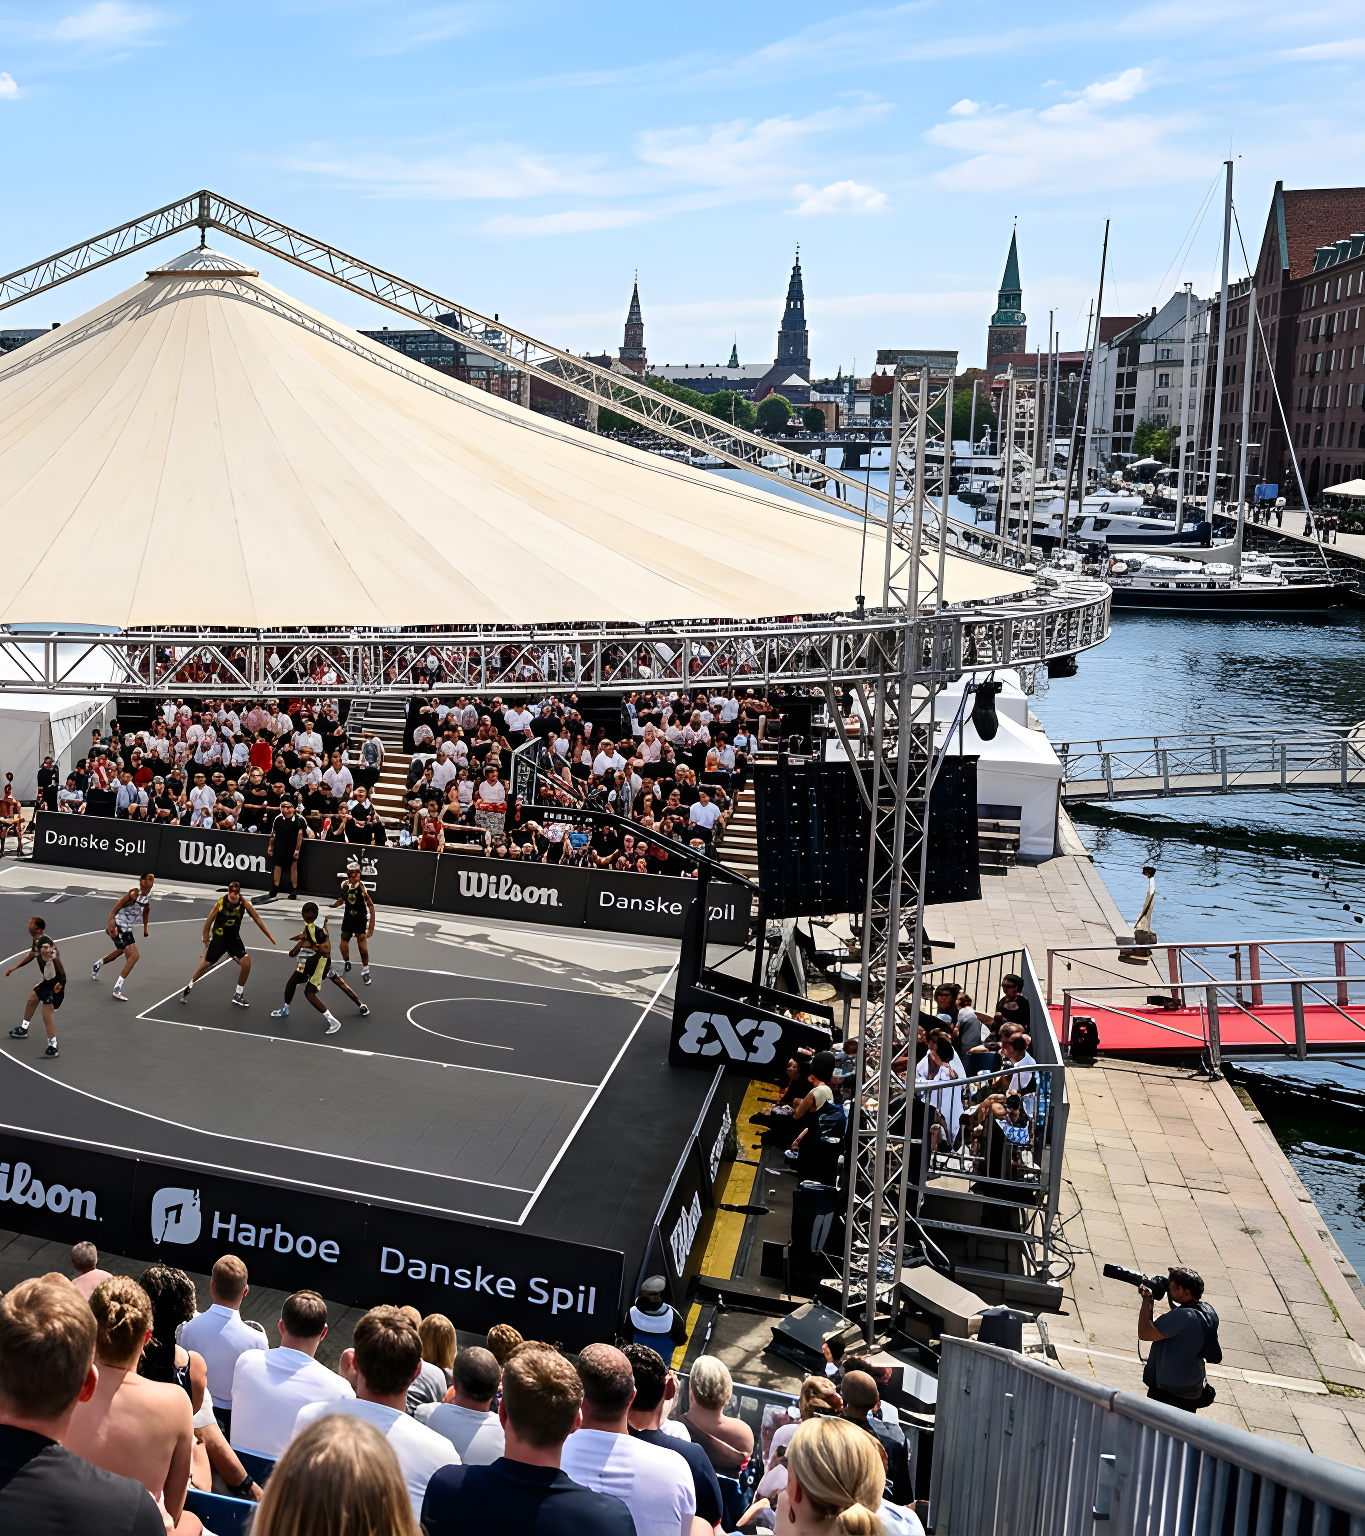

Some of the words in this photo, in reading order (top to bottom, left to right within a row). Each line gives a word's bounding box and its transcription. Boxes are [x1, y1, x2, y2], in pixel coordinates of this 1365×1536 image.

[599, 891, 683, 915] Danske
[211, 1210, 340, 1263] Harboe
[380, 1246, 517, 1299] Danske
[527, 1276, 596, 1315] Spil
